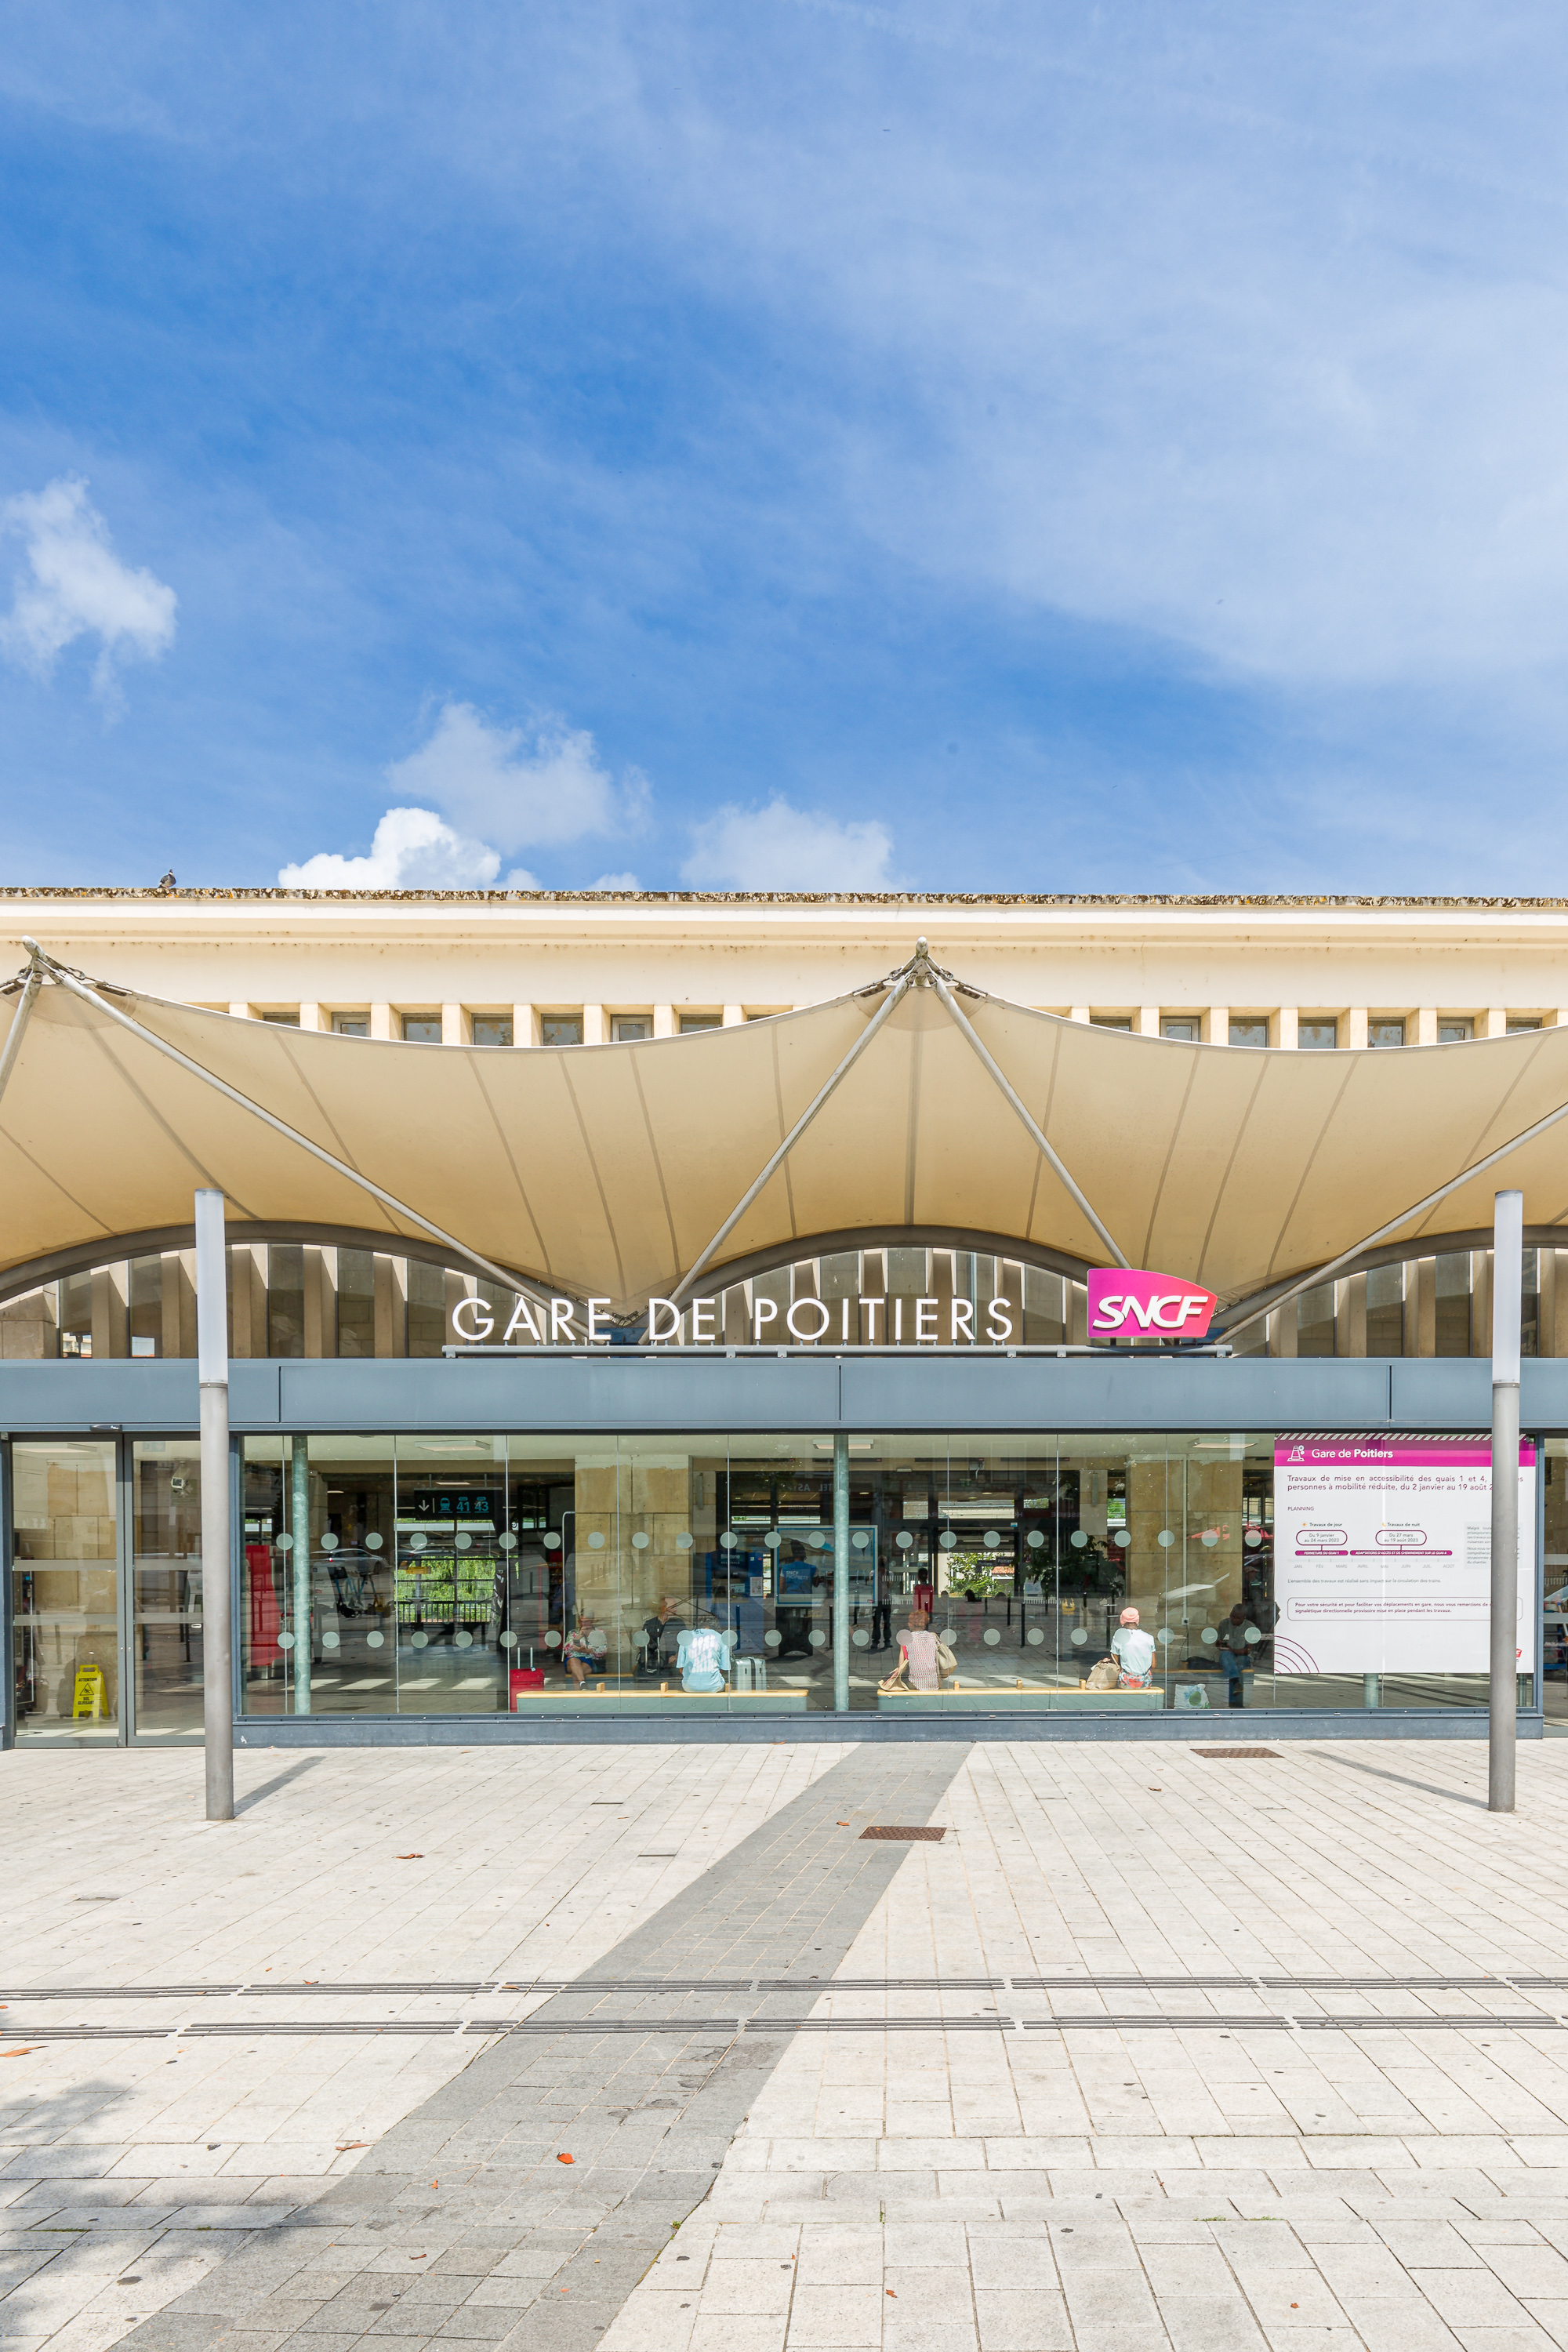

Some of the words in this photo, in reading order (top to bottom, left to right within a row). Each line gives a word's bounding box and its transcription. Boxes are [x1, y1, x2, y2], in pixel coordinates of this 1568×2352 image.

[1092, 1295, 1209, 1329] SNCF
[452, 1298, 612, 1341] GARE
[648, 1298, 716, 1341] DE
[754, 1298, 1013, 1340] POITIERS
[1311, 1449, 1336, 1458] Gare
[1338, 1449, 1352, 1458] de
[1353, 1449, 1394, 1458] Poitiers
[1436, 1475, 1456, 1484] quais
[1368, 1483, 1398, 1491] réduite,
[1419, 1483, 1445, 1492] janvier
[456, 1501, 470, 1512] 41
[474, 1501, 489, 1512] 43
